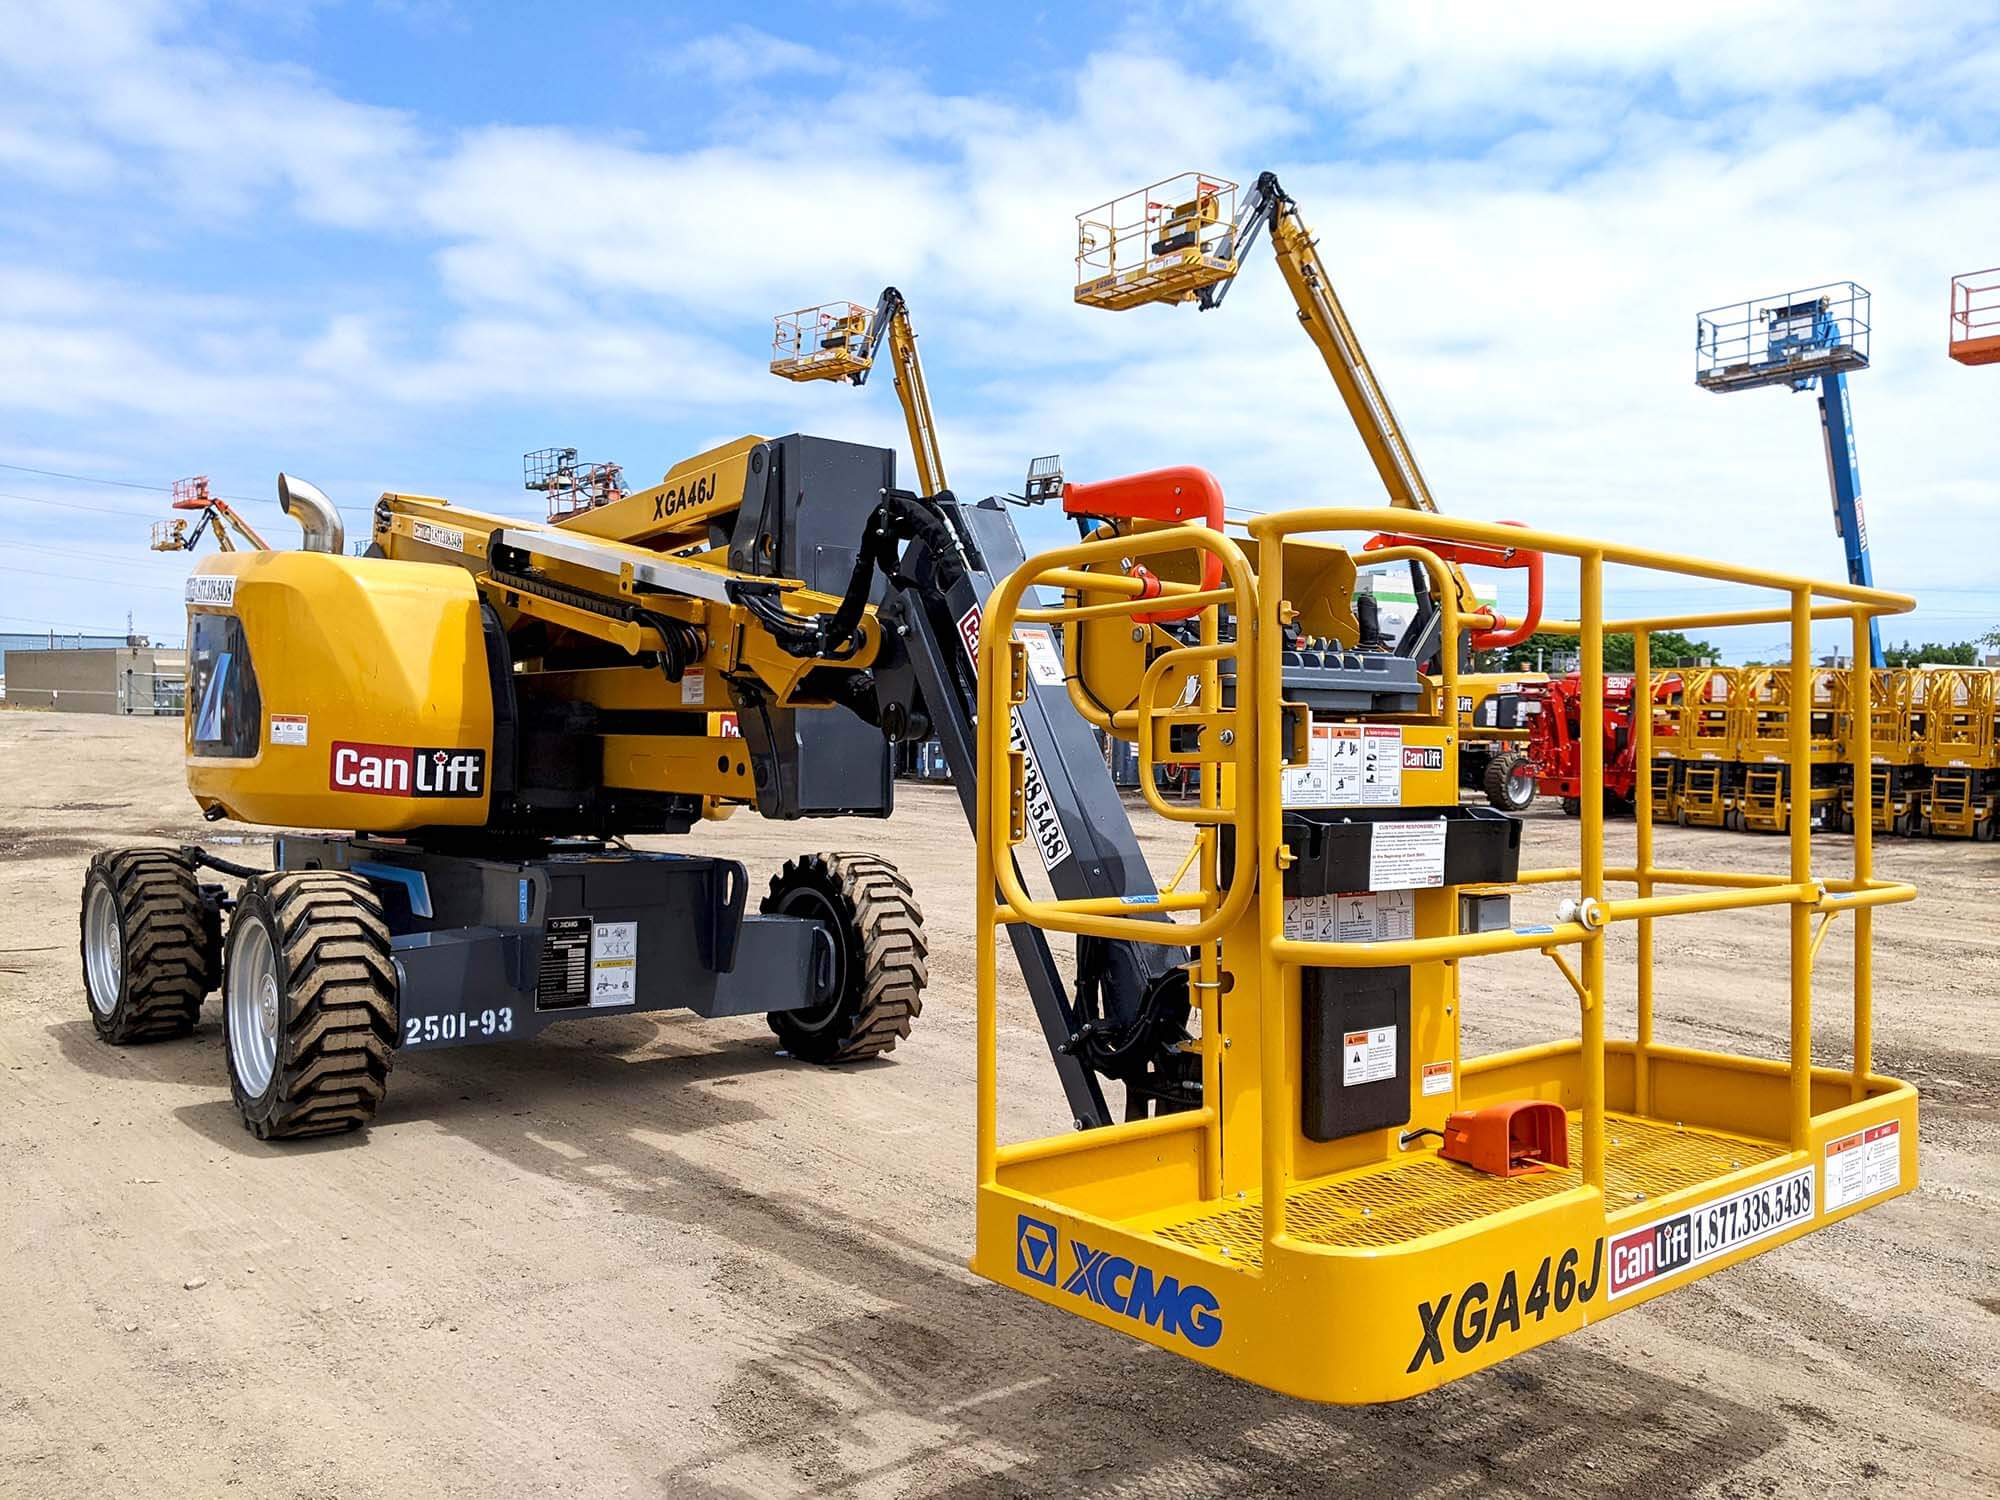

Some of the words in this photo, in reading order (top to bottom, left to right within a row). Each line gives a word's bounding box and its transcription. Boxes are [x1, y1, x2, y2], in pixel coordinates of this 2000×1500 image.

[653, 473, 716, 521] XGA46J
[1696, 1175, 1810, 1253] 1.877.338.5438
[1061, 1240, 1222, 1348] XCMG
[1406, 1237, 1604, 1373] XGA46J
